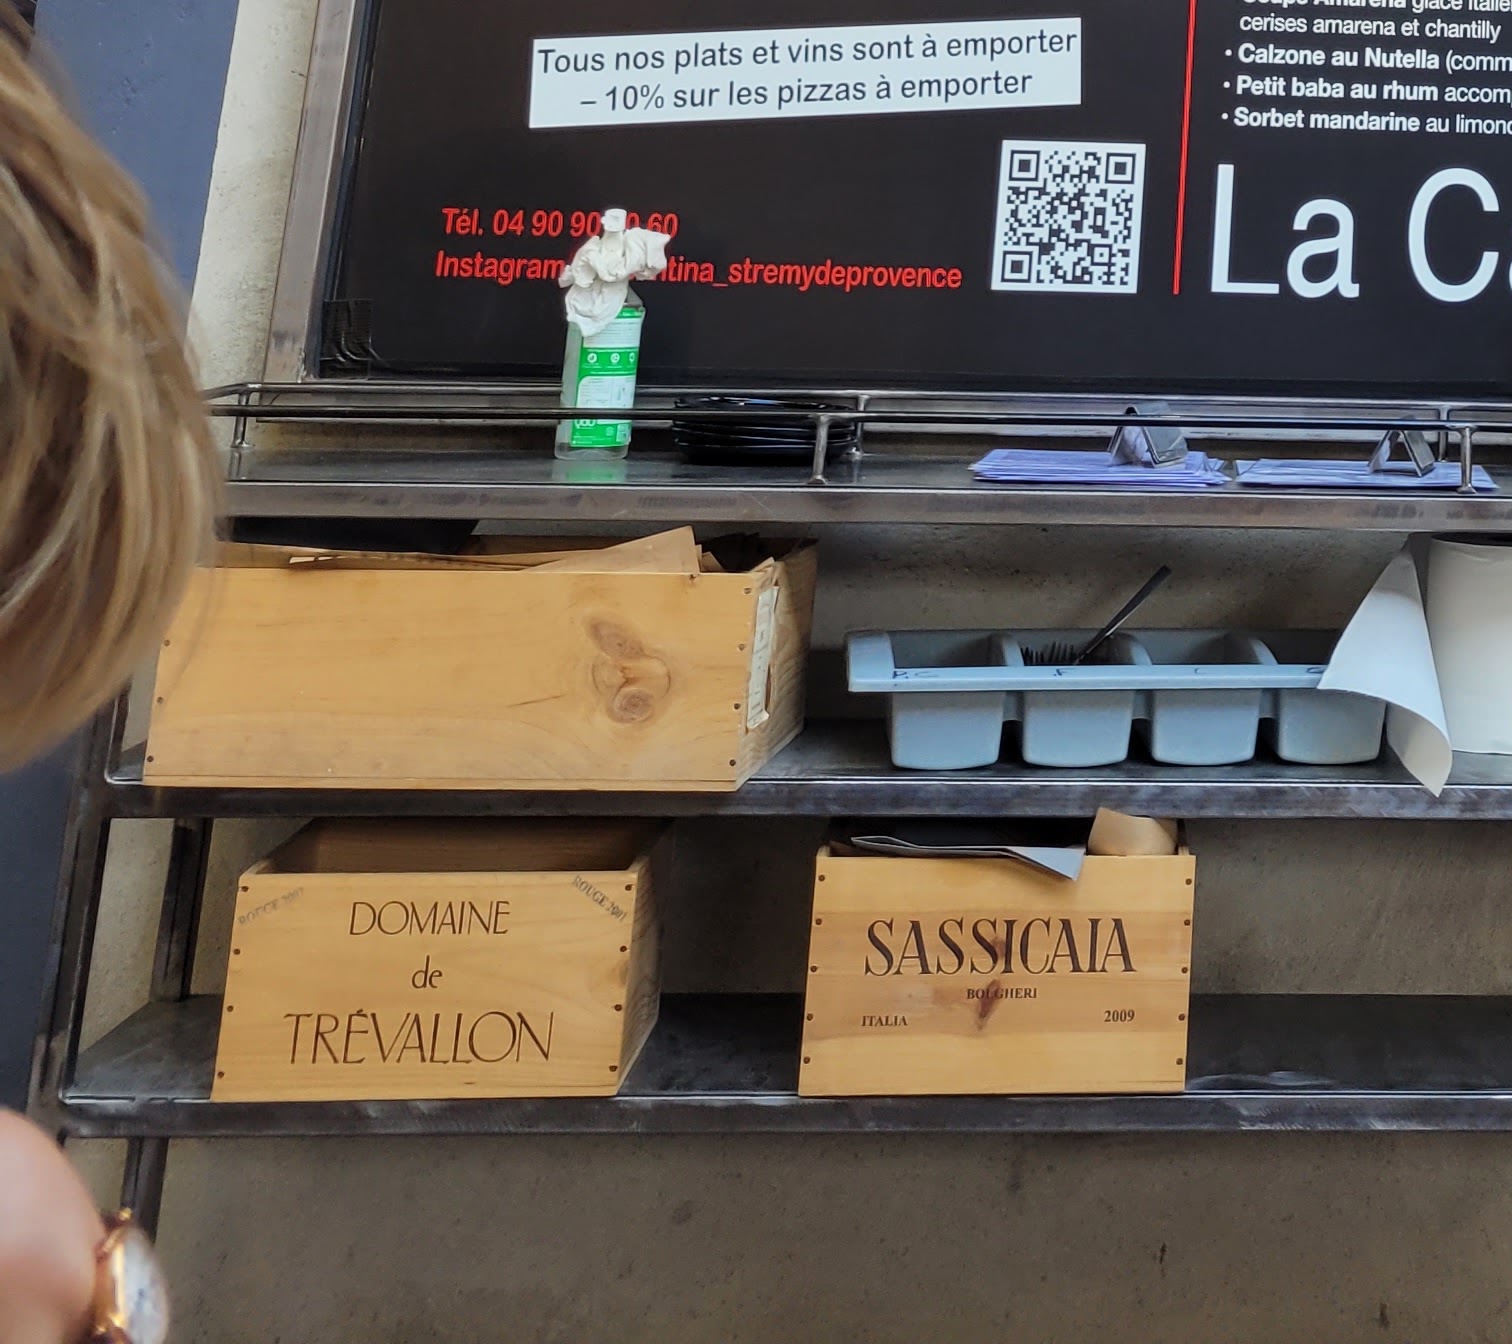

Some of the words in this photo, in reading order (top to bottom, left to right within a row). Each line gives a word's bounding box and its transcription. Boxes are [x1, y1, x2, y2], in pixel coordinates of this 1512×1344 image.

[537, 49, 605, 74] Tous
[615, 49, 665, 71] nos
[674, 38, 743, 74] plats
[753, 42, 780, 65] et
[788, 36, 843, 63] vins
[853, 36, 913, 61] sont
[922, 33, 938, 58] à
[946, 29, 1077, 62] emporter
[605, 83, 665, 111] 10%
[673, 85, 719, 108] sur
[728, 79, 769, 105] les
[778, 76, 866, 109] pizzas
[876, 74, 892, 99] à
[900, 70, 1033, 103] emporter
[1237, 75, 1286, 96] Petit
[1291, 77, 1344, 98] baba
[1350, 83, 1377, 99] au
[1383, 80, 1438, 101] rhum
[442, 208, 484, 237] Tél.
[493, 210, 525, 237] 04
[531, 211, 563, 238] 90
[570, 211, 600, 238] 90
[1210, 164, 1360, 300] La
[435, 250, 564, 286] Instagram
[572, 874, 609, 908] ROUGE
[350, 900, 510, 935] DOMAINE
[864, 916, 1137, 976] SASSICAIA
[411, 955, 443, 989] de
[967, 987, 1037, 1000] BOLGHERI
[861, 1015, 908, 1027] ITALIA
[1104, 1009, 1135, 1023] 2009
[284, 1009, 554, 1064] TRÉVALLON
